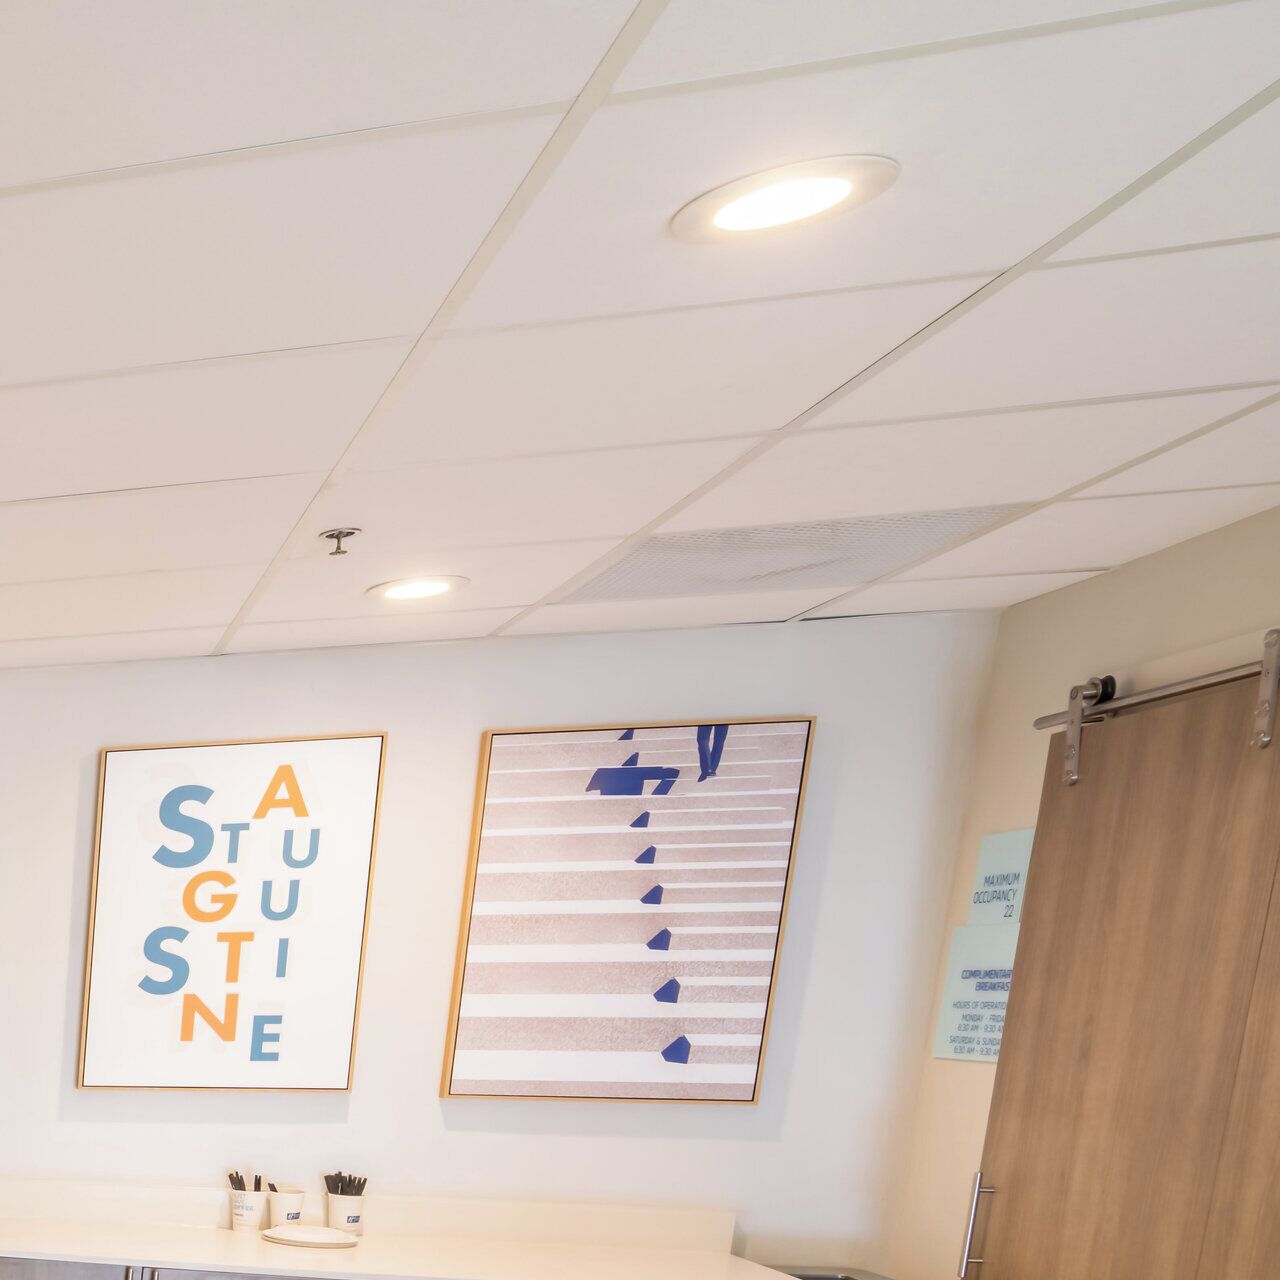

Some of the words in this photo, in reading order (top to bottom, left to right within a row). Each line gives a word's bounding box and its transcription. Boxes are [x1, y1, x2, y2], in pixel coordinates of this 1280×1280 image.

[984, 872, 1020, 887] MAXIMUM
[973, 889, 1017, 904] OCCUPANCY
[1004, 905, 1014, 917] 22
[961, 969, 1013, 979] COMPLIMENTAR
[989, 1014, 1005, 1023] FRIDA
[982, 1037, 1000, 1046] SUNDA
